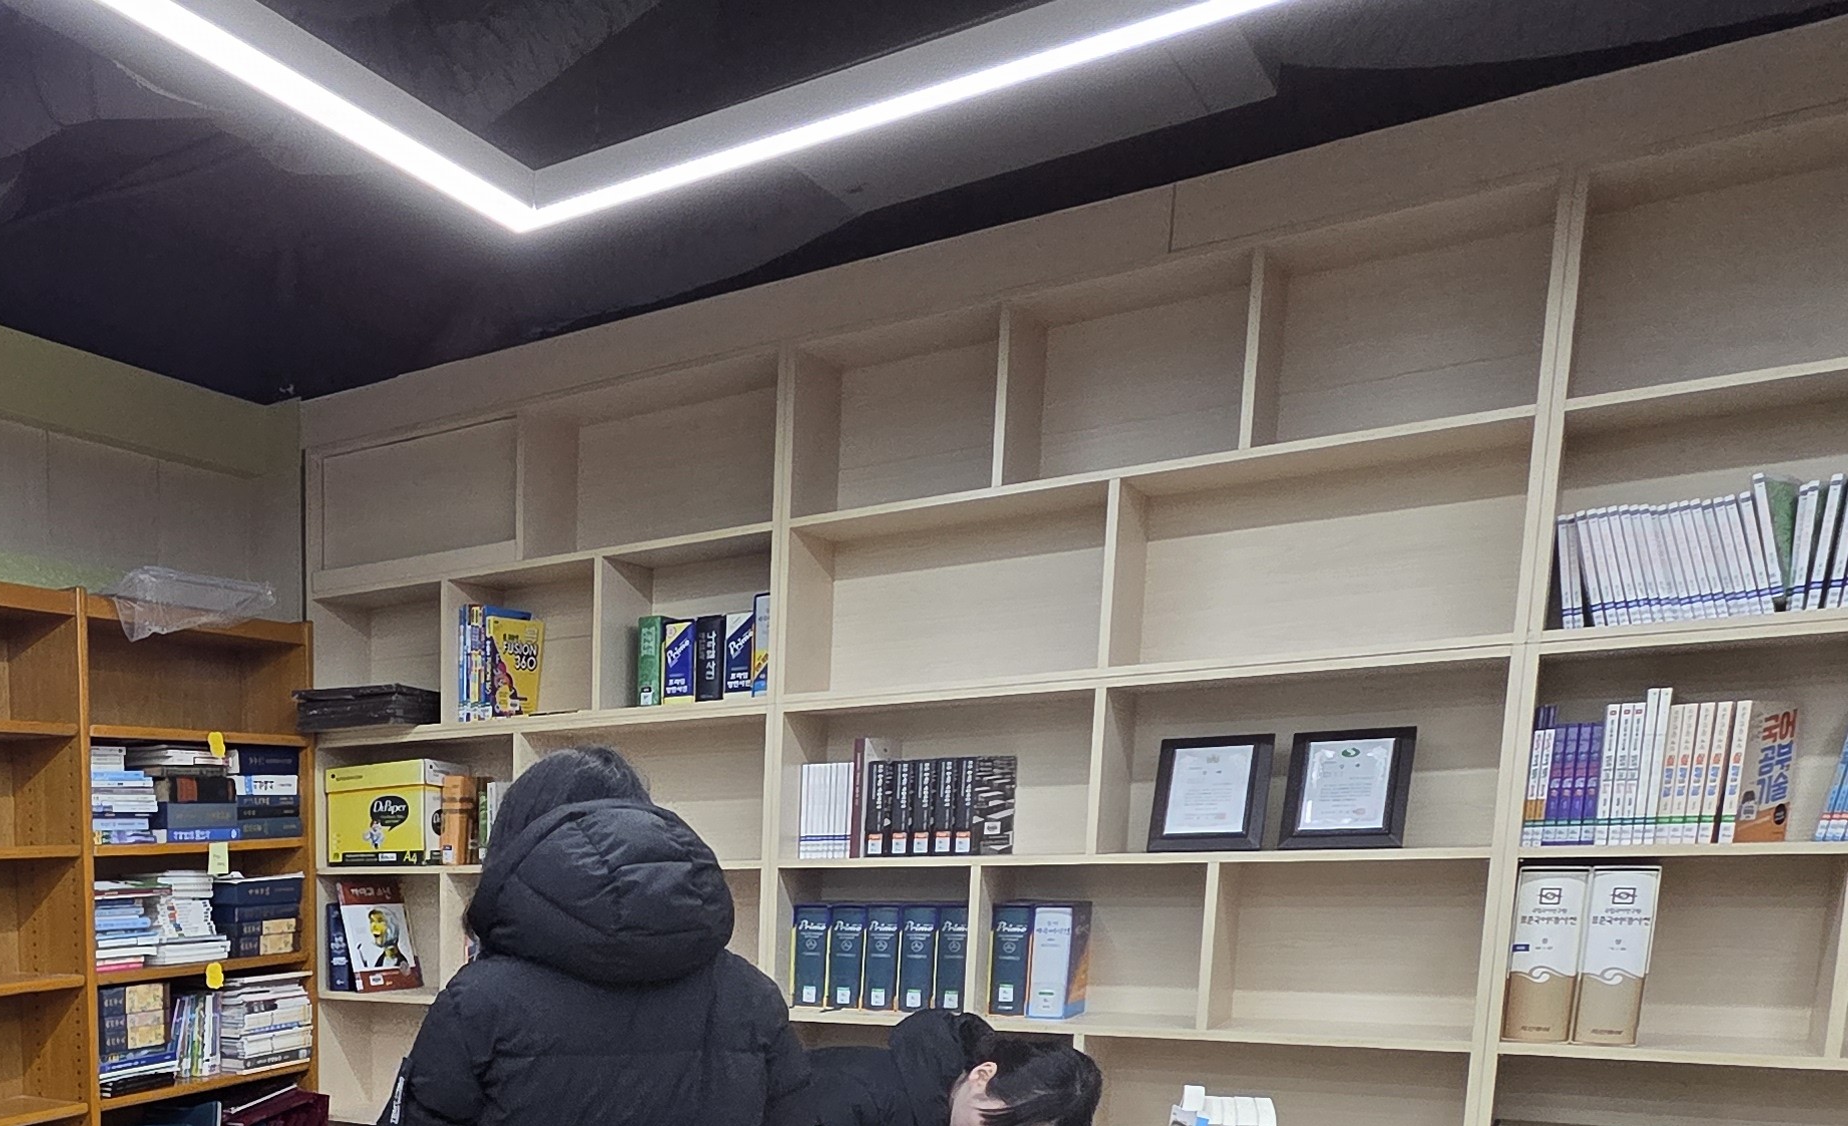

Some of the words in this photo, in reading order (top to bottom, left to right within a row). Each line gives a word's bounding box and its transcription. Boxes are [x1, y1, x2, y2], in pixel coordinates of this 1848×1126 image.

[503, 641, 538, 656] FUSION
[514, 656, 537, 671] 360
[1756, 773, 1788, 805] 기술
[403, 852, 418, 865] A4
[799, 920, 826, 931] Prime
[834, 920, 862, 931] Prime
[870, 921, 897, 932] Prime
[905, 921, 934, 932] Prime
[997, 921, 1027, 932] Prime
